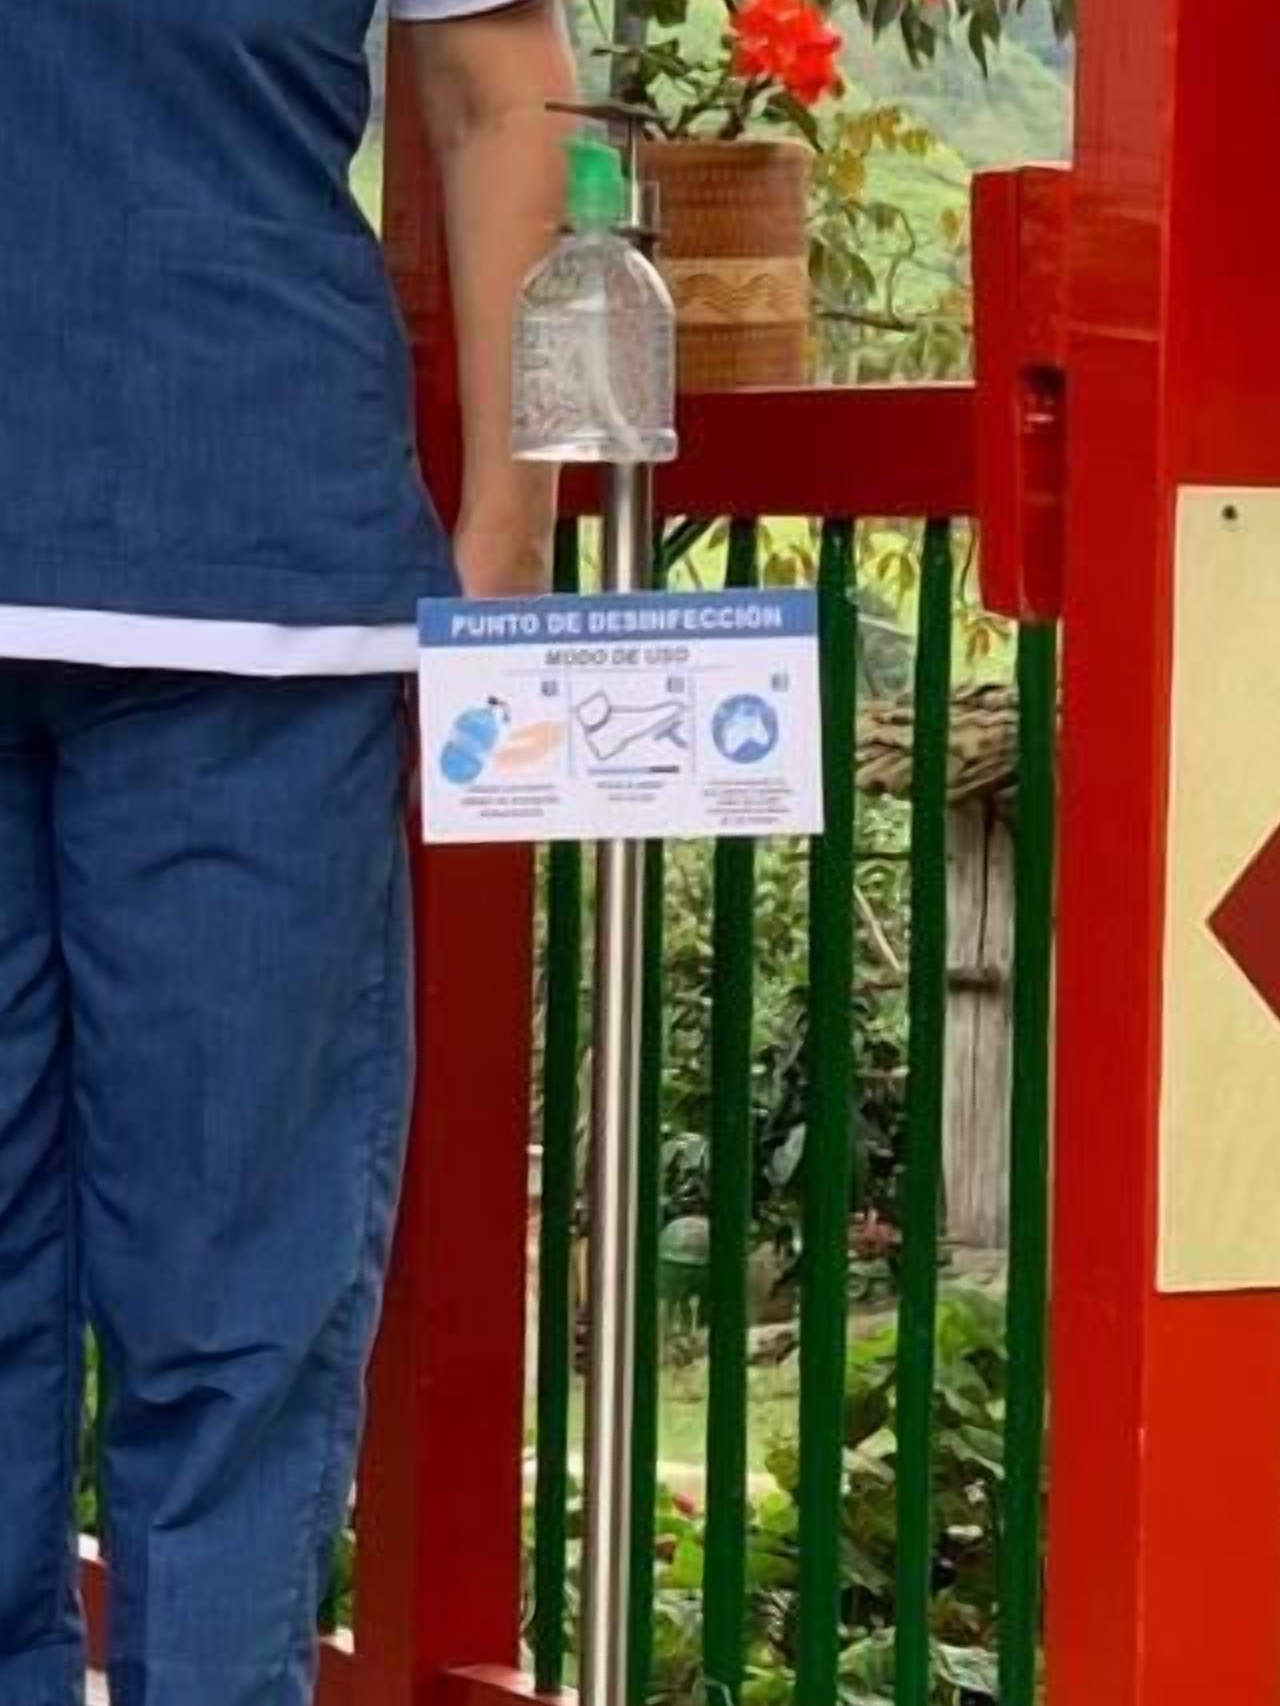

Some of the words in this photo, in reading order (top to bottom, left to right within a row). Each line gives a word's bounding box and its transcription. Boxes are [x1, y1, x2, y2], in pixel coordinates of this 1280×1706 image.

[452, 613, 540, 637] PUNTO
[547, 612, 581, 634] DE
[587, 605, 783, 634] DESINFECCIÓN
[544, 649, 609, 666] MODO
[612, 648, 638, 665] DE
